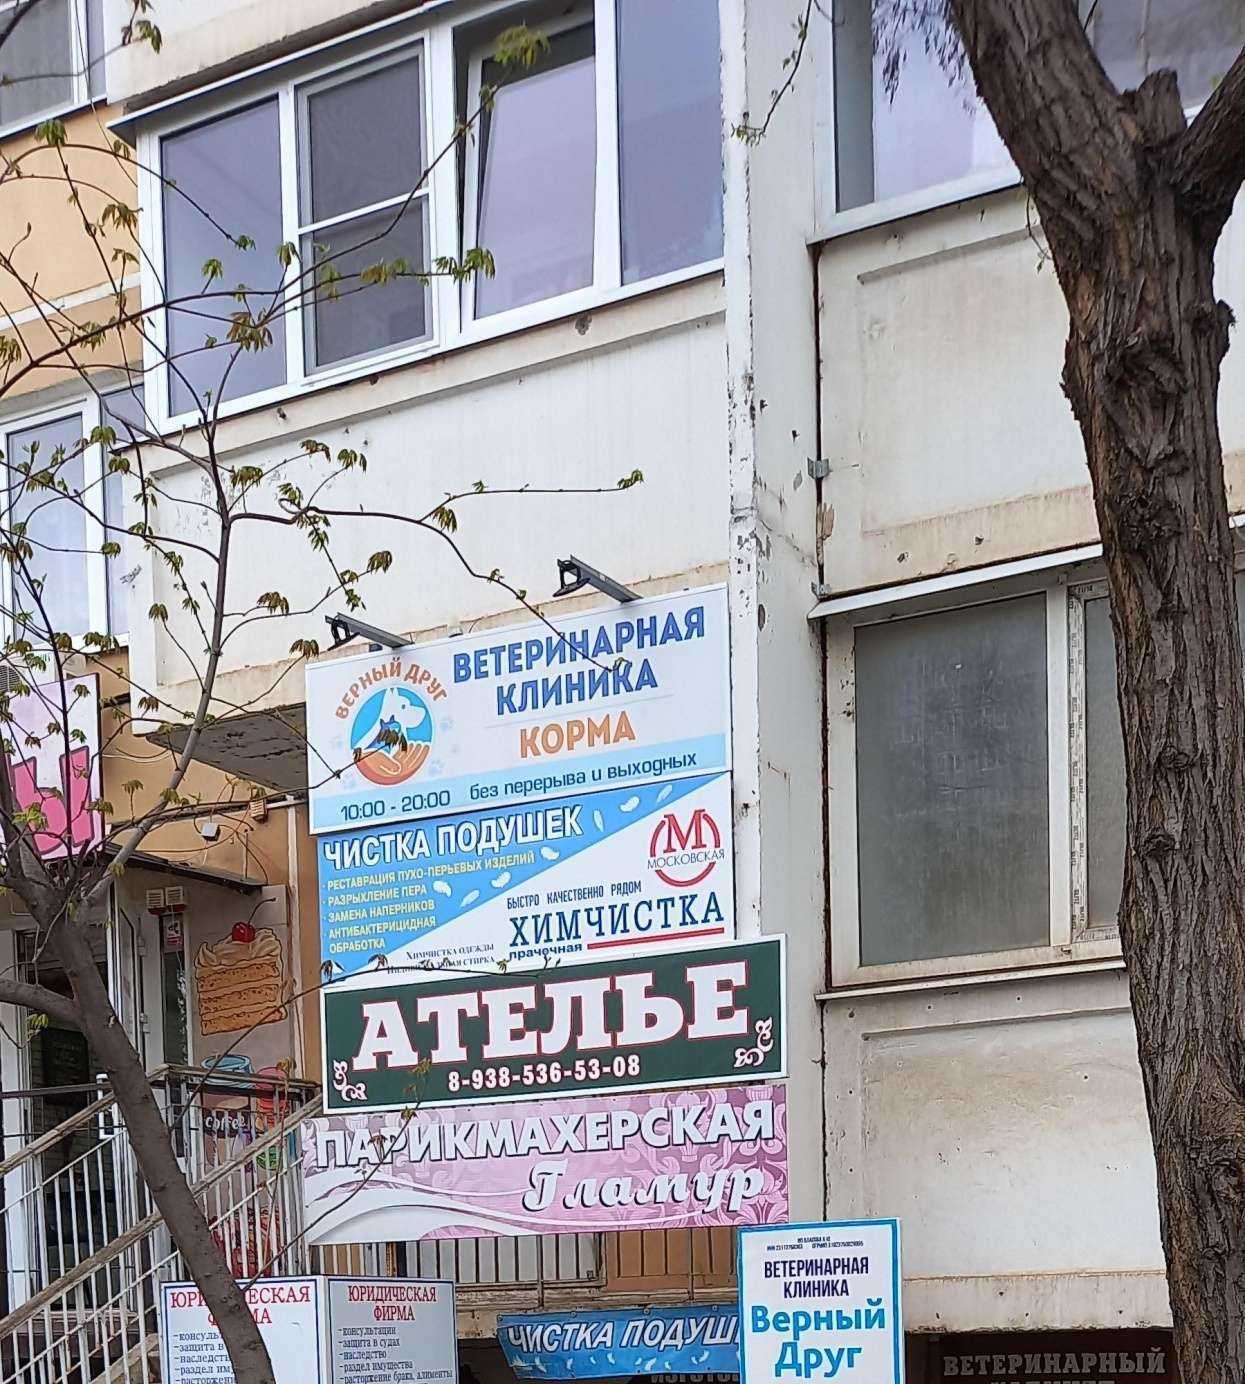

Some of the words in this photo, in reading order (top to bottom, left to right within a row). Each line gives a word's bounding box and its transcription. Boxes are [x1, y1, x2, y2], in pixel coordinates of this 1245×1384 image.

[453, 606, 705, 683] ВЕТЕРИНАРНАЯ
[336, 657, 401, 719] ВЕРНЫЙ
[404, 663, 447, 701] ДРУГ
[497, 658, 657, 715] КЛИНИКА
[519, 710, 636, 758] КОРМА
[341, 801, 385, 822] 10:00
[401, 790, 450, 810] 20:00
[469, 781, 500, 800] без
[504, 770, 587, 798] перерыва
[591, 768, 601, 782] и
[607, 752, 697, 782] выходных
[324, 829, 431, 871] ЧИСТКА
[436, 804, 584, 855] ПОДУШЕК
[327, 871, 396, 890] РЕСТАВРАЦИЯ
[399, 859, 482, 881] ПУХО-ПЕРЬЕВЫХ
[484, 852, 535, 870] ИЗДЕЛИЙ
[647, 848, 725, 871] МОСКОВСКАЯ
[328, 889, 399, 906] РАЗРЫХЛЕНИЕ
[402, 885, 428, 896] ПЕРА
[328, 910, 368, 923] ЗАМЕНА
[369, 900, 435, 918] НАПЕРНИКОВ
[506, 893, 540, 910] БЫСТРО
[546, 886, 605, 906] КАЧЕСТВЕННО
[610, 879, 642, 898] РЯДОМ
[329, 917, 436, 938] АНТИБАКТЕРИЦИДНАЯ
[509, 890, 725, 948] ХИМЧИСТКА
[329, 938, 385, 954] ОБРАБОТКА
[352, 961, 749, 1072] АТЕЛЬЕ
[448, 1053, 641, 1092] 8-938-536-53-08
[316, 1100, 775, 1169] ПАРИКМАХЕРСКАЯ
[522, 1158, 765, 1215] Гламур
[764, 1256, 869, 1278] ВЕТЕРИНАРНАЯ
[348, 1286, 436, 1303] ЮРИДИЧЕСКАЯ
[784, 1279, 849, 1298] КЛИНИКА
[374, 1306, 415, 1321] ФИРМА
[751, 1298, 886, 1340] Верный
[507, 1319, 614, 1354] ЧИСТКА
[620, 1314, 739, 1351] ПОДУШ
[774, 1341, 863, 1378] Друг
[943, 1346, 1166, 1376] ВЕТЕРИНАРНЫЙ
